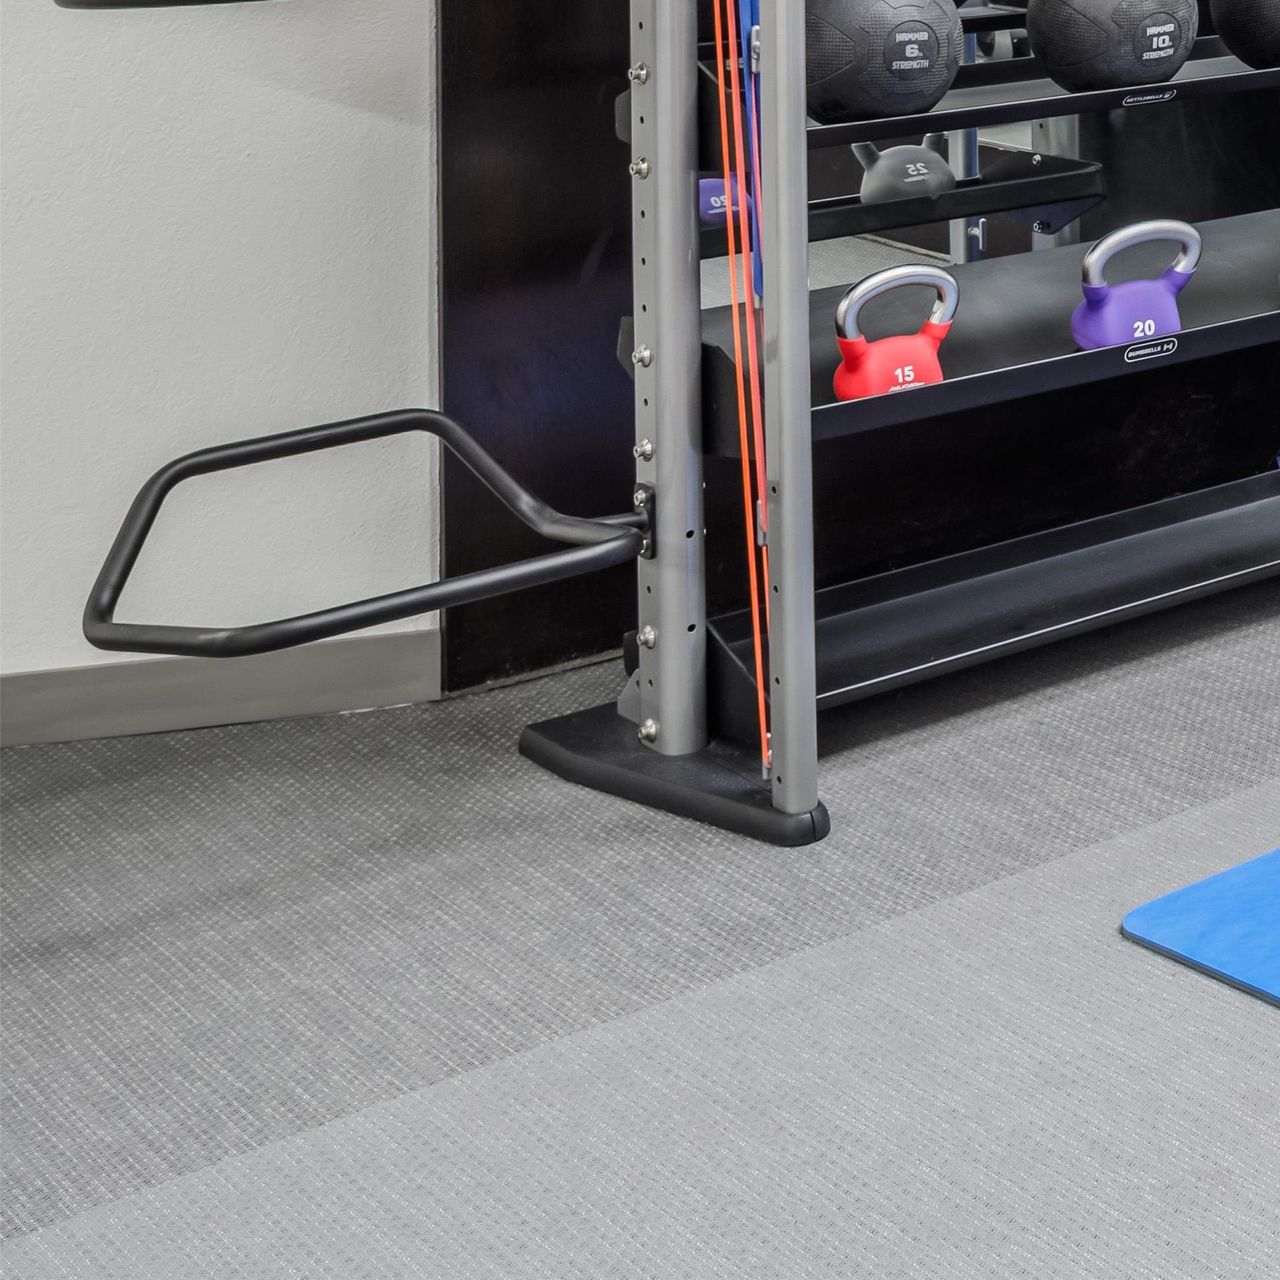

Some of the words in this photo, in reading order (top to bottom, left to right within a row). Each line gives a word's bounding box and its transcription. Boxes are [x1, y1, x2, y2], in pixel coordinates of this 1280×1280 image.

[1146, 23, 1175, 36] HAMMER
[895, 32, 929, 42] HAMMER
[1142, 48, 1175, 60] STRENGTH
[891, 59, 930, 70] STRENGTH
[1133, 319, 1156, 338] 20
[894, 365, 915, 383] 15
